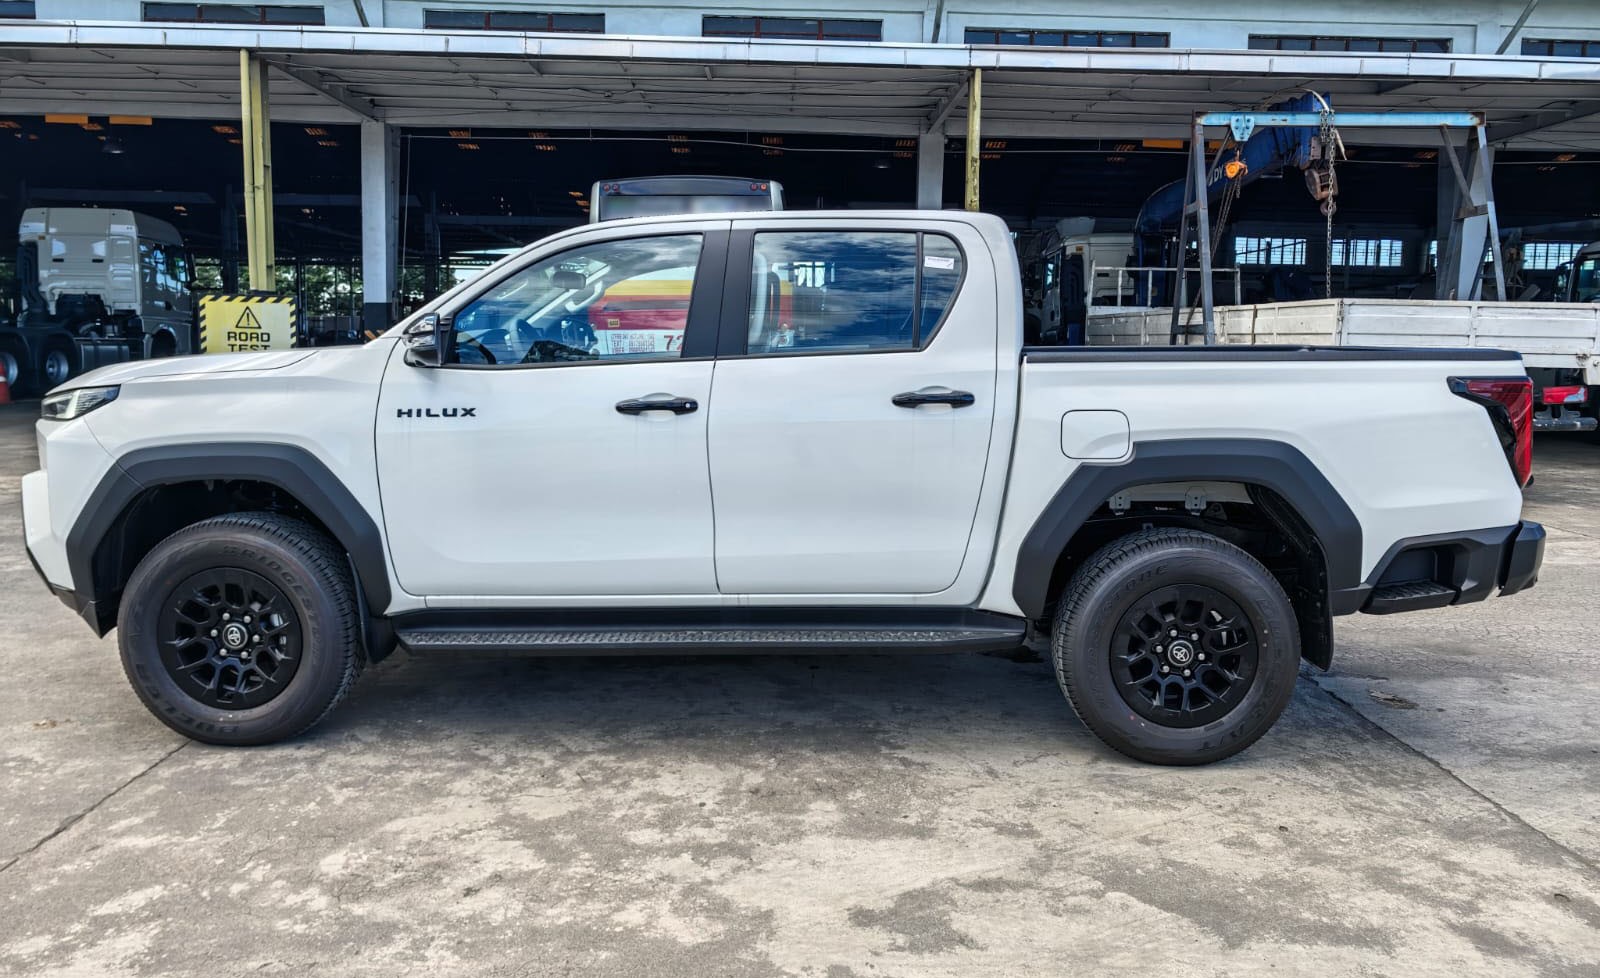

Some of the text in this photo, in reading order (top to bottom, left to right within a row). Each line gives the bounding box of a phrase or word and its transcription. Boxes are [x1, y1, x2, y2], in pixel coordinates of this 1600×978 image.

[227, 331, 271, 342] ROAD
[228, 343, 271, 352] TEST
[396, 407, 477, 418] HILUX
